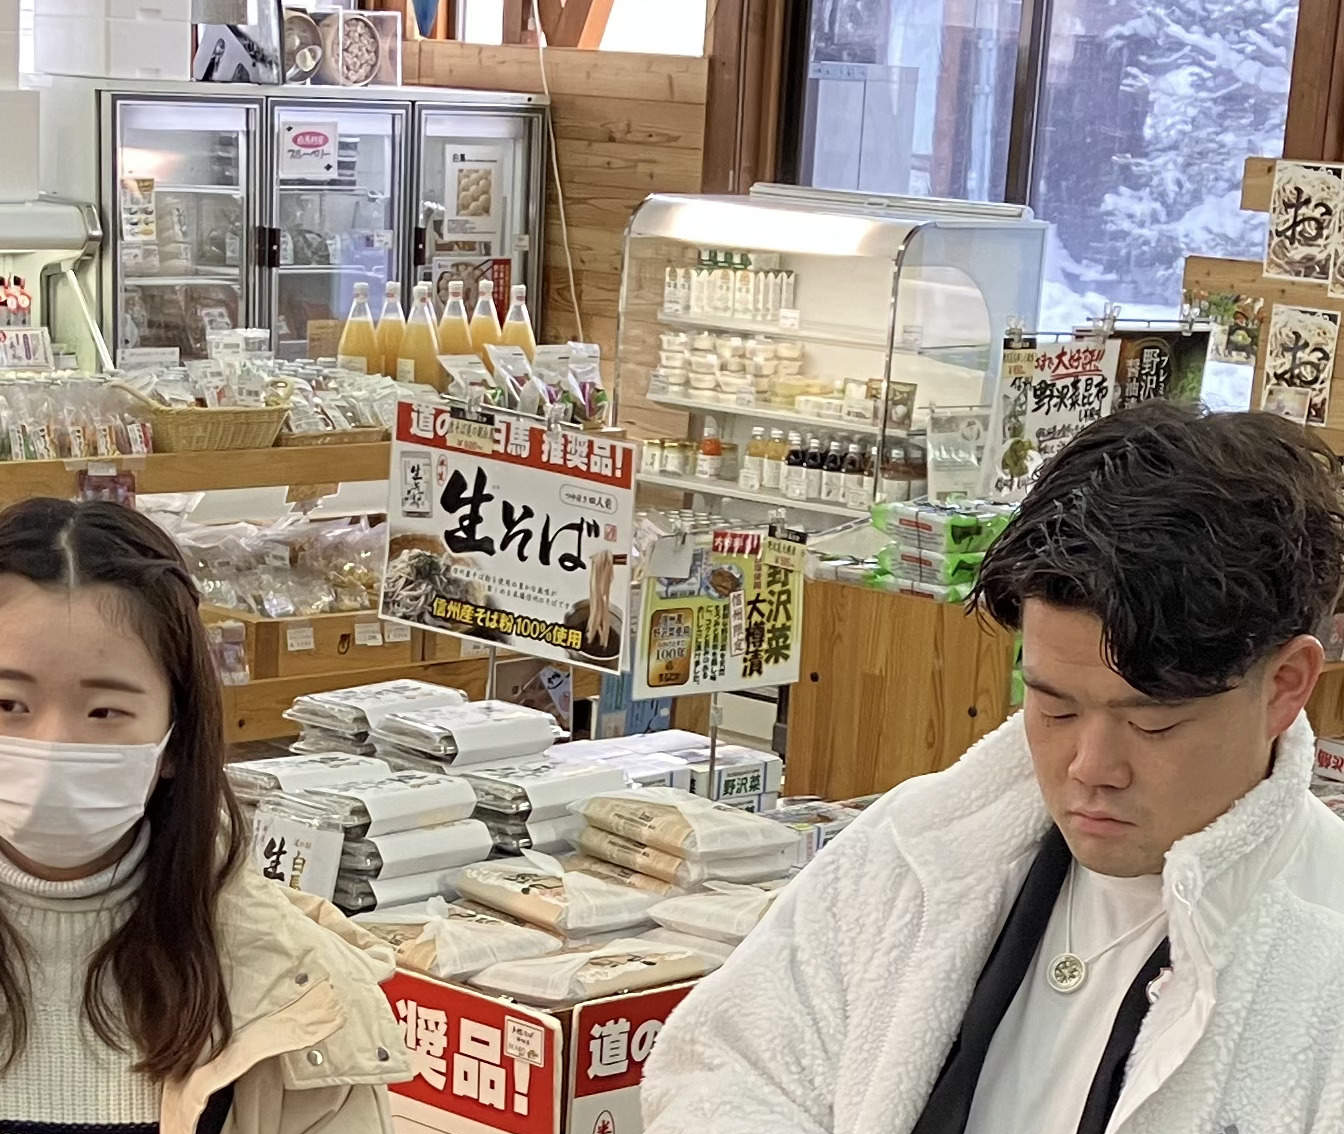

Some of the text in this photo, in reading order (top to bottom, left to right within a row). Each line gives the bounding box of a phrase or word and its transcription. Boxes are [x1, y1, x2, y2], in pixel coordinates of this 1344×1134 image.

[440, 466, 600, 572] 生そば
[433, 597, 583, 649] 信州産そば粉100%使用
[722, 774, 761, 797] 野沢菜
